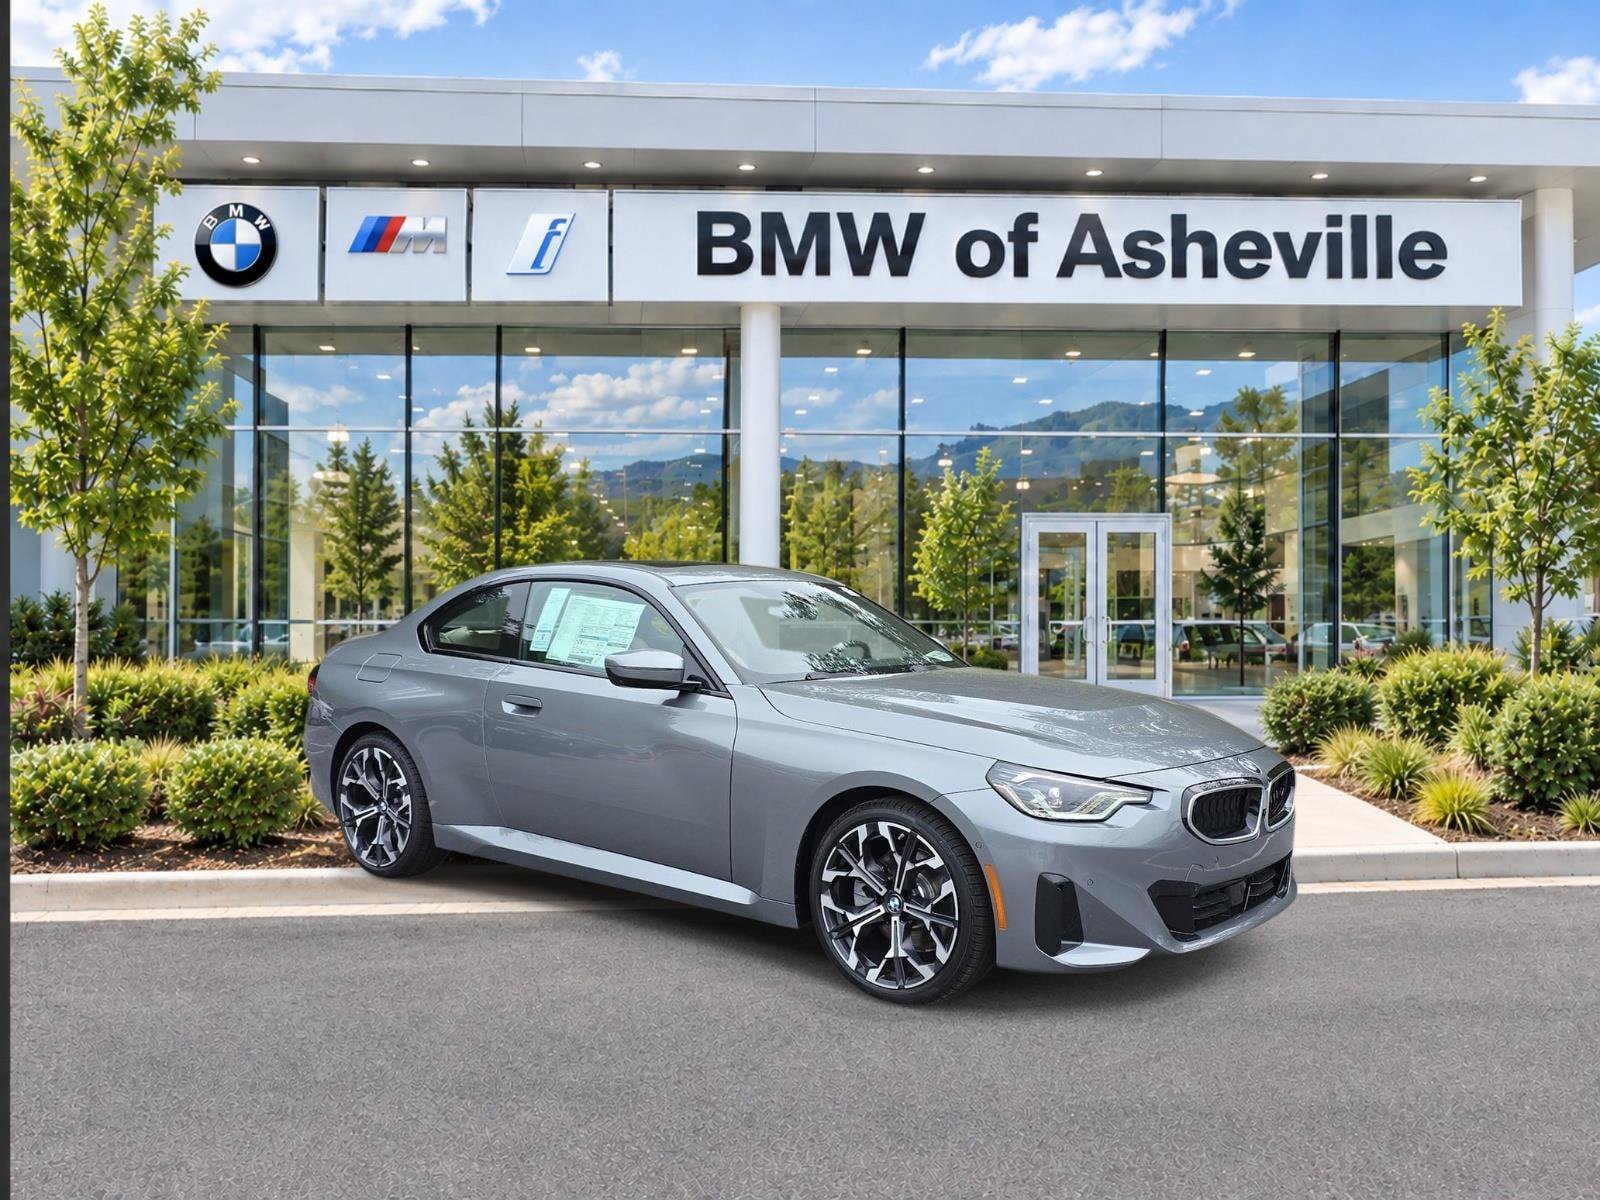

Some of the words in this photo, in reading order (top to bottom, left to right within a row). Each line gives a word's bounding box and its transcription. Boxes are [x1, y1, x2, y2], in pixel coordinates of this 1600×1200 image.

[202, 204, 271, 230] BMW
[696, 210, 926, 278] BMW
[955, 211, 1039, 279] of
[1055, 213, 1448, 281] Asheville
